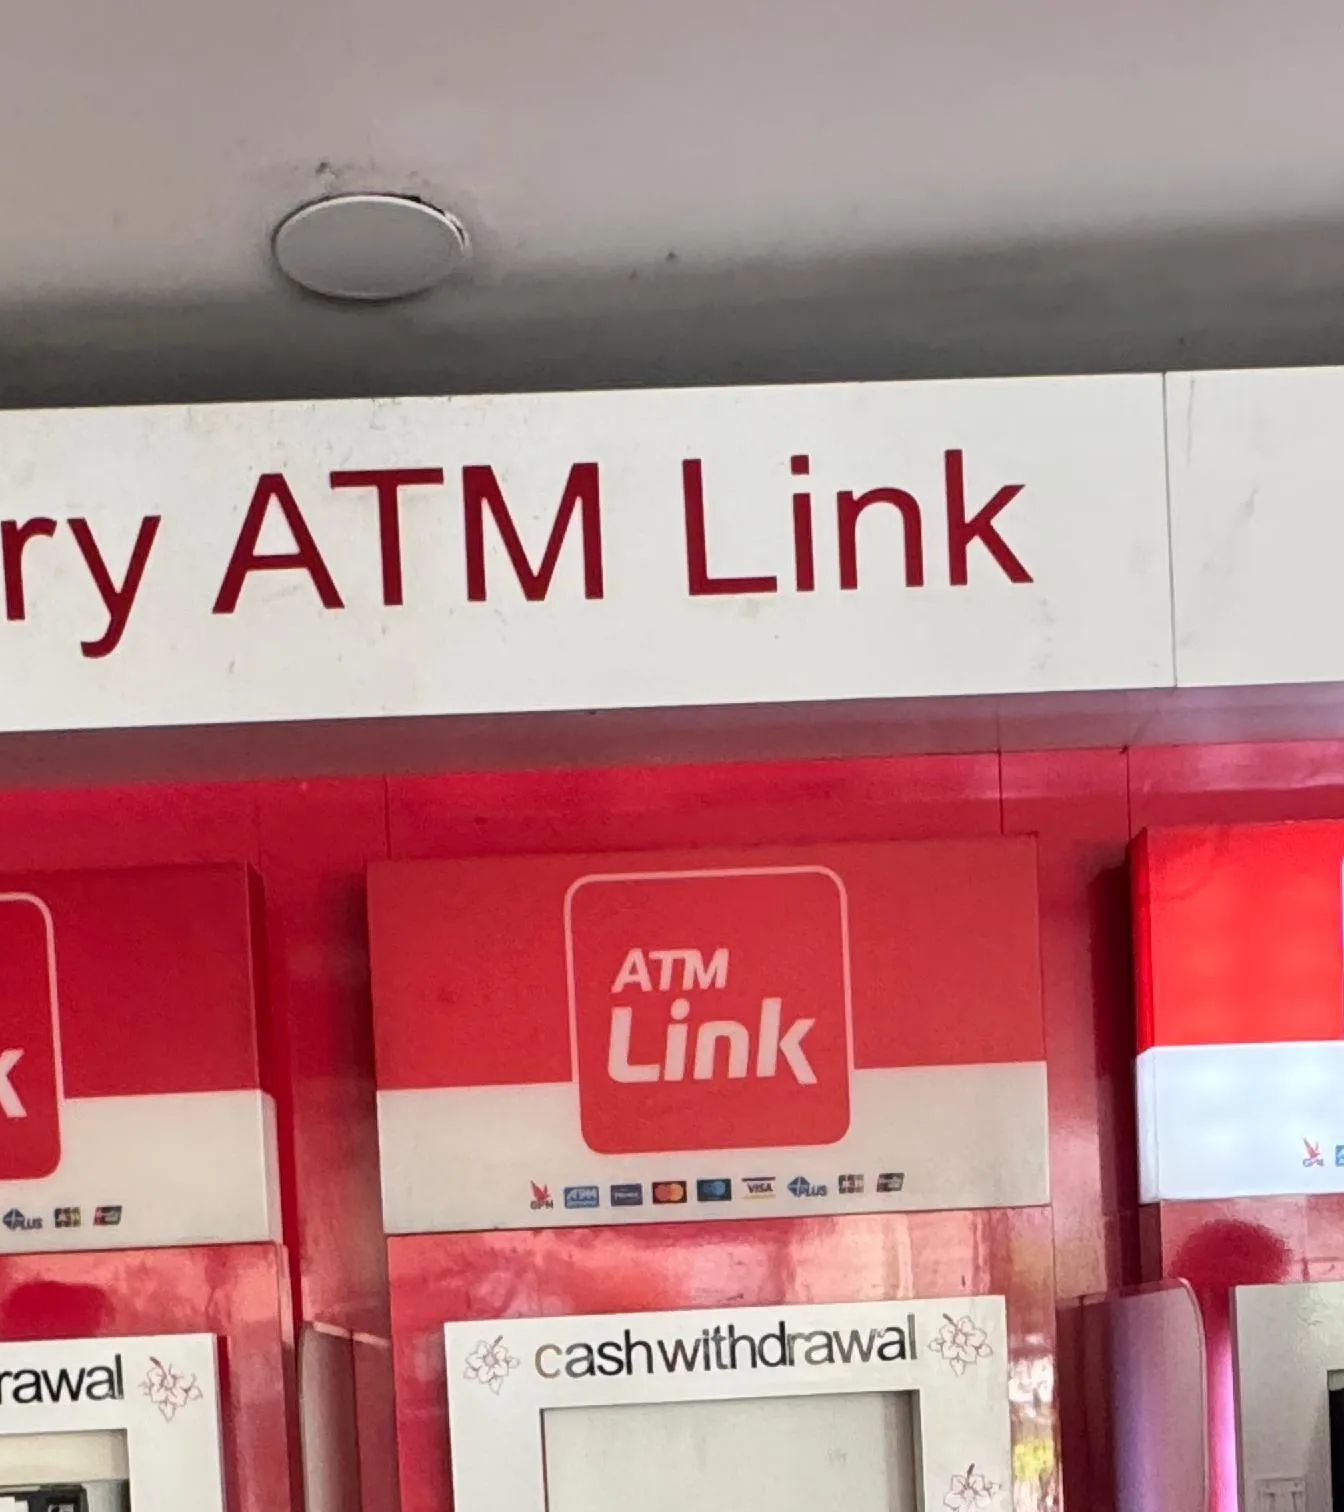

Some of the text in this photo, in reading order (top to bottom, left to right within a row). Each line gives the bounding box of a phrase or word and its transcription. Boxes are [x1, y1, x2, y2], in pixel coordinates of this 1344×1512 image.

[211, 462, 604, 615] ATM
[681, 448, 1034, 596] Link
[611, 947, 730, 993] ATM
[607, 997, 818, 1085] Link
[747, 1183, 774, 1195] VISA
